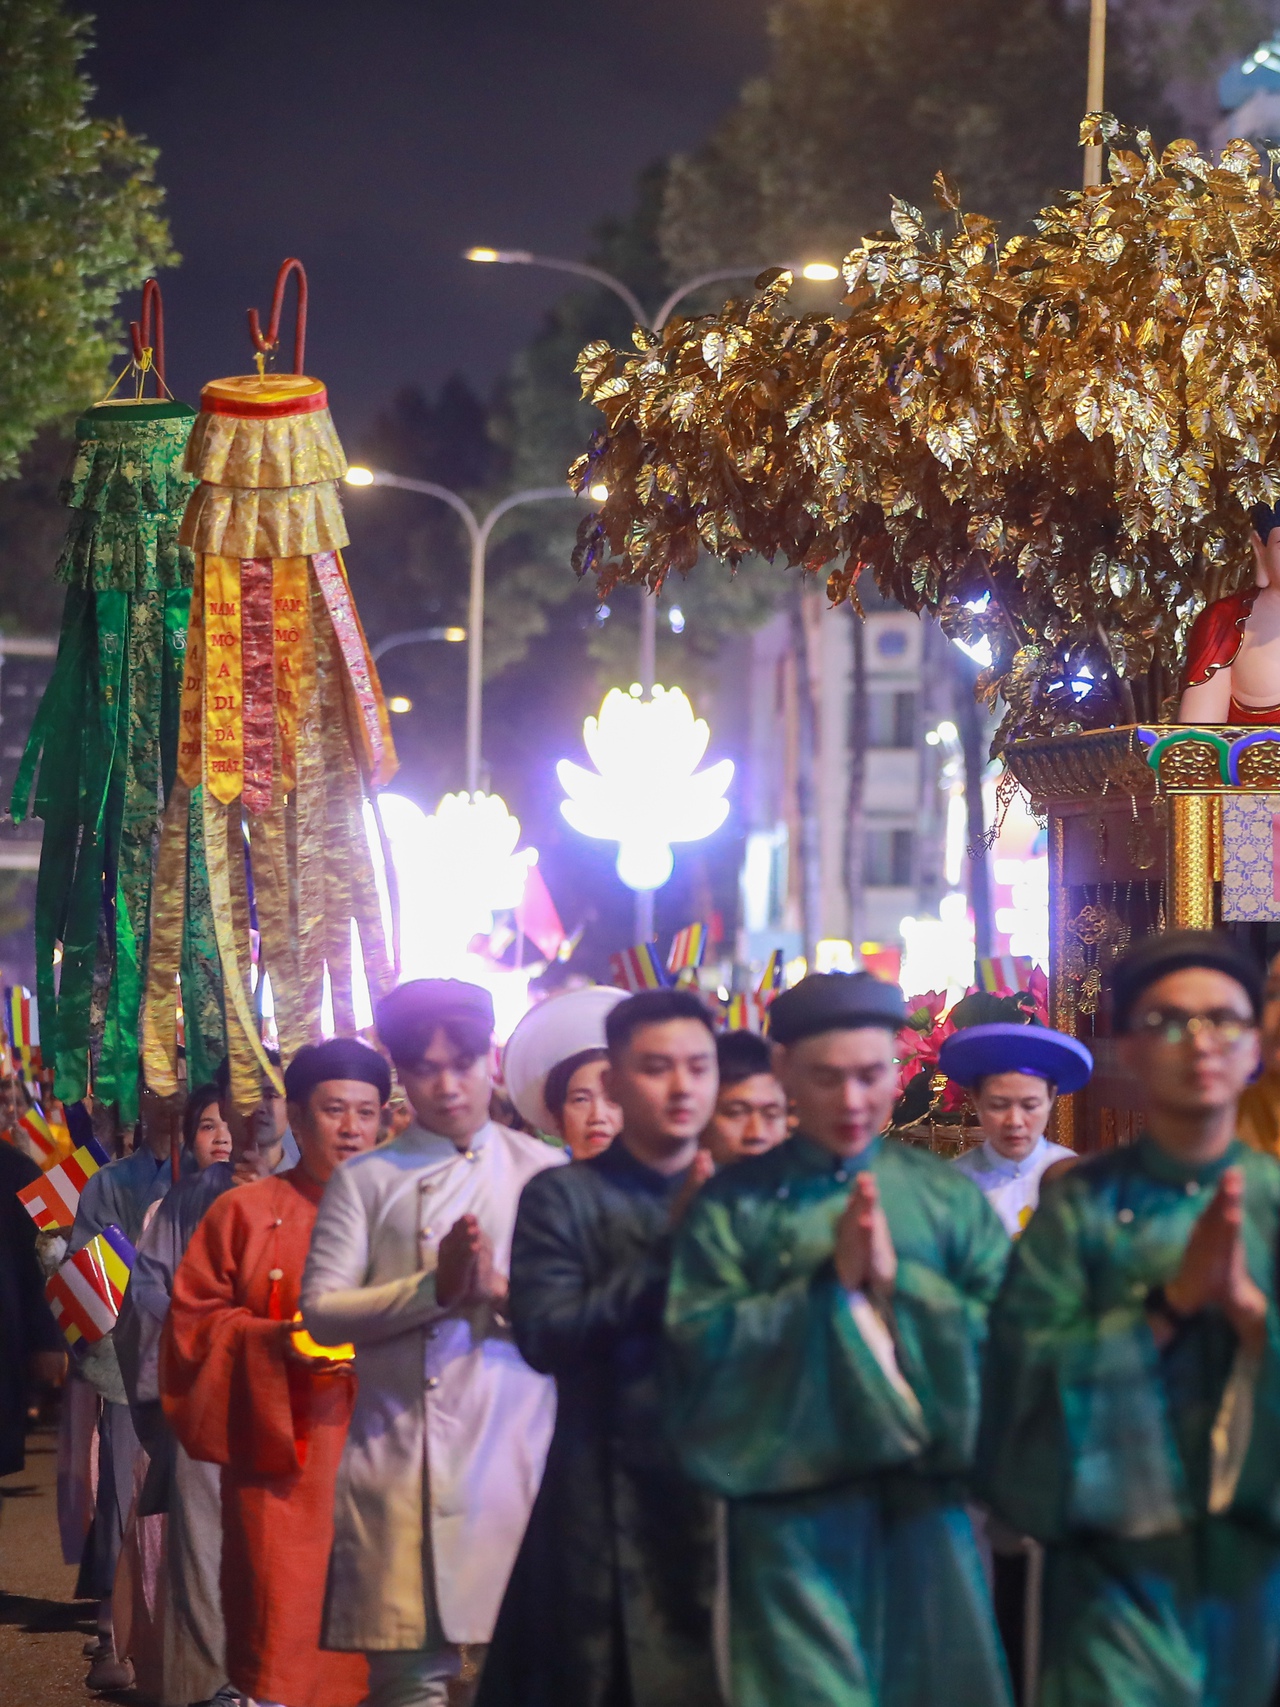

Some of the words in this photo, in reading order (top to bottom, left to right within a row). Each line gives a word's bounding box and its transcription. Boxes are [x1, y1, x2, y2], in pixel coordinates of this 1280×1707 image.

[210, 602, 236, 616] NAM
[274, 598, 301, 612] NAM
[211, 631, 236, 647] MÔ
[275, 626, 300, 642] MÔ
[217, 662, 231, 678] A
[279, 657, 291, 672] A
[215, 696, 235, 710] DI
[276, 688, 292, 704] DI
